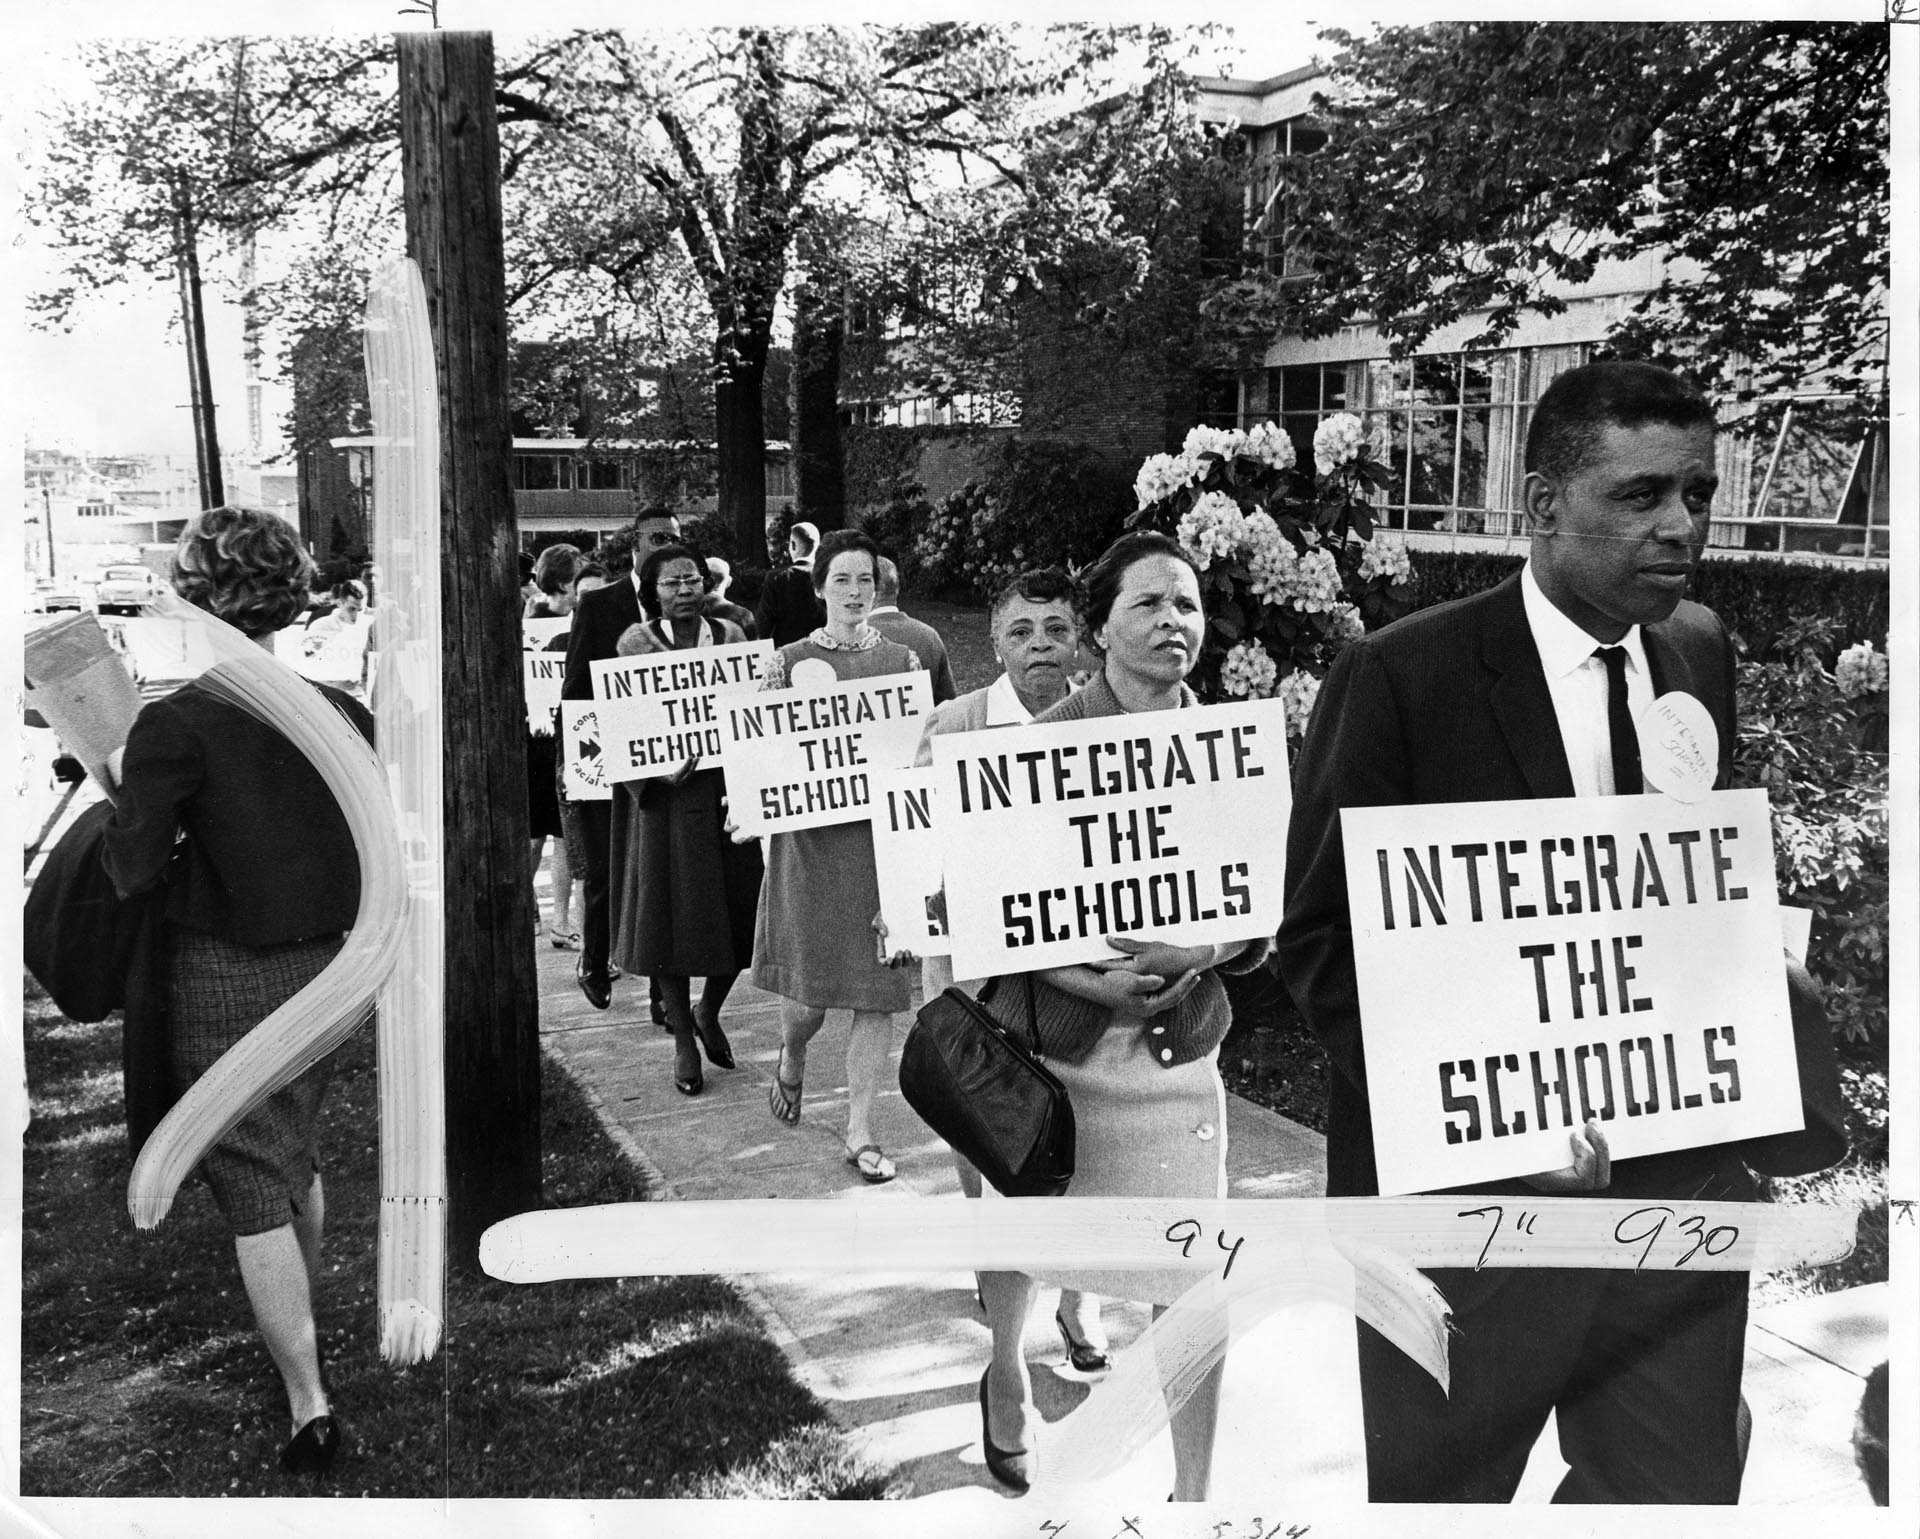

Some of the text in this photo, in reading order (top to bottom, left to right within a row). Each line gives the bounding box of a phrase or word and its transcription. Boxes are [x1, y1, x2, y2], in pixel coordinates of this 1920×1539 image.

[603, 653, 763, 700] INTEGRATE
[662, 694, 717, 726] THE
[730, 685, 919, 741] INTEGRATE
[571, 761, 600, 787] racial
[799, 733, 867, 771] THE
[957, 725, 1265, 814] INTEGRATE
[887, 787, 937, 832] IN
[1068, 805, 1179, 868] THE
[1001, 862, 1251, 948] SCHOOLS
[1376, 827, 1749, 931] INTEGRATE
[1519, 935, 1654, 1023] THE
[1438, 1026, 1742, 1145] SCHOOLS
